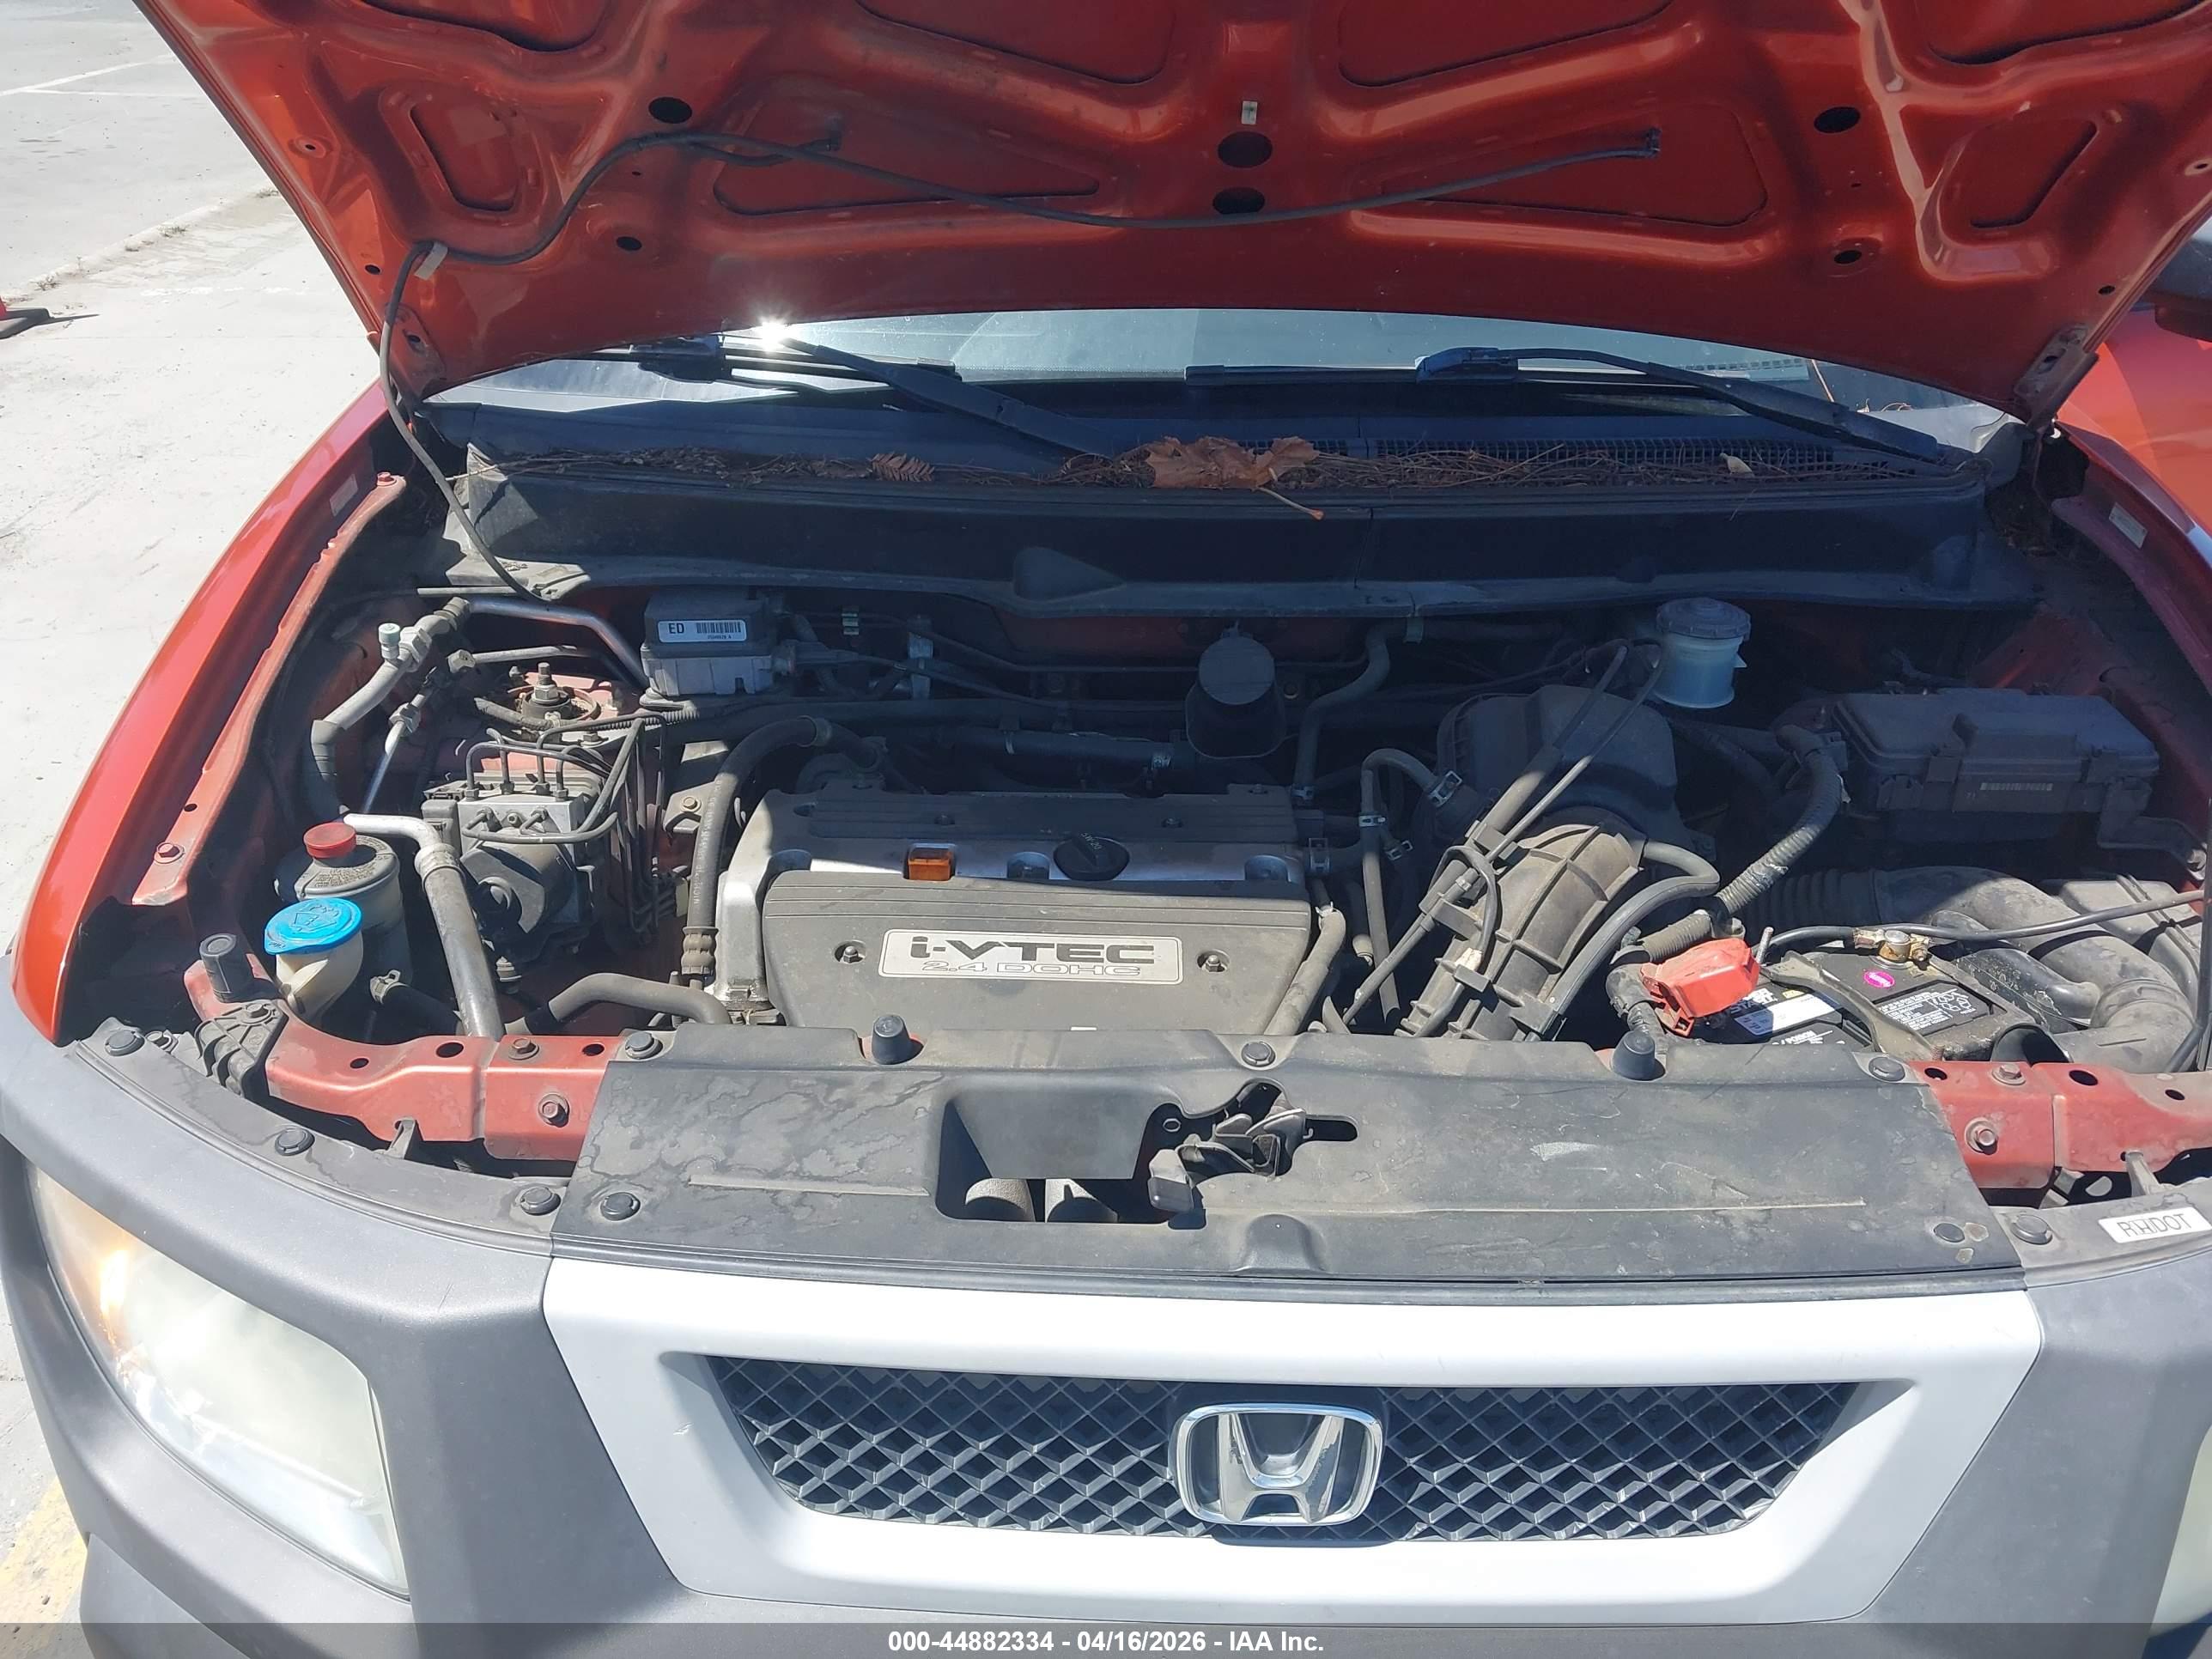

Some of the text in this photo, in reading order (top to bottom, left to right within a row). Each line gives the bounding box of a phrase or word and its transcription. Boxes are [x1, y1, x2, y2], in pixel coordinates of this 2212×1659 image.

[668, 623, 685, 635] ED
[909, 935, 1156, 965] i-VTEC
[921, 960, 1141, 976] 2.4 DOHC
